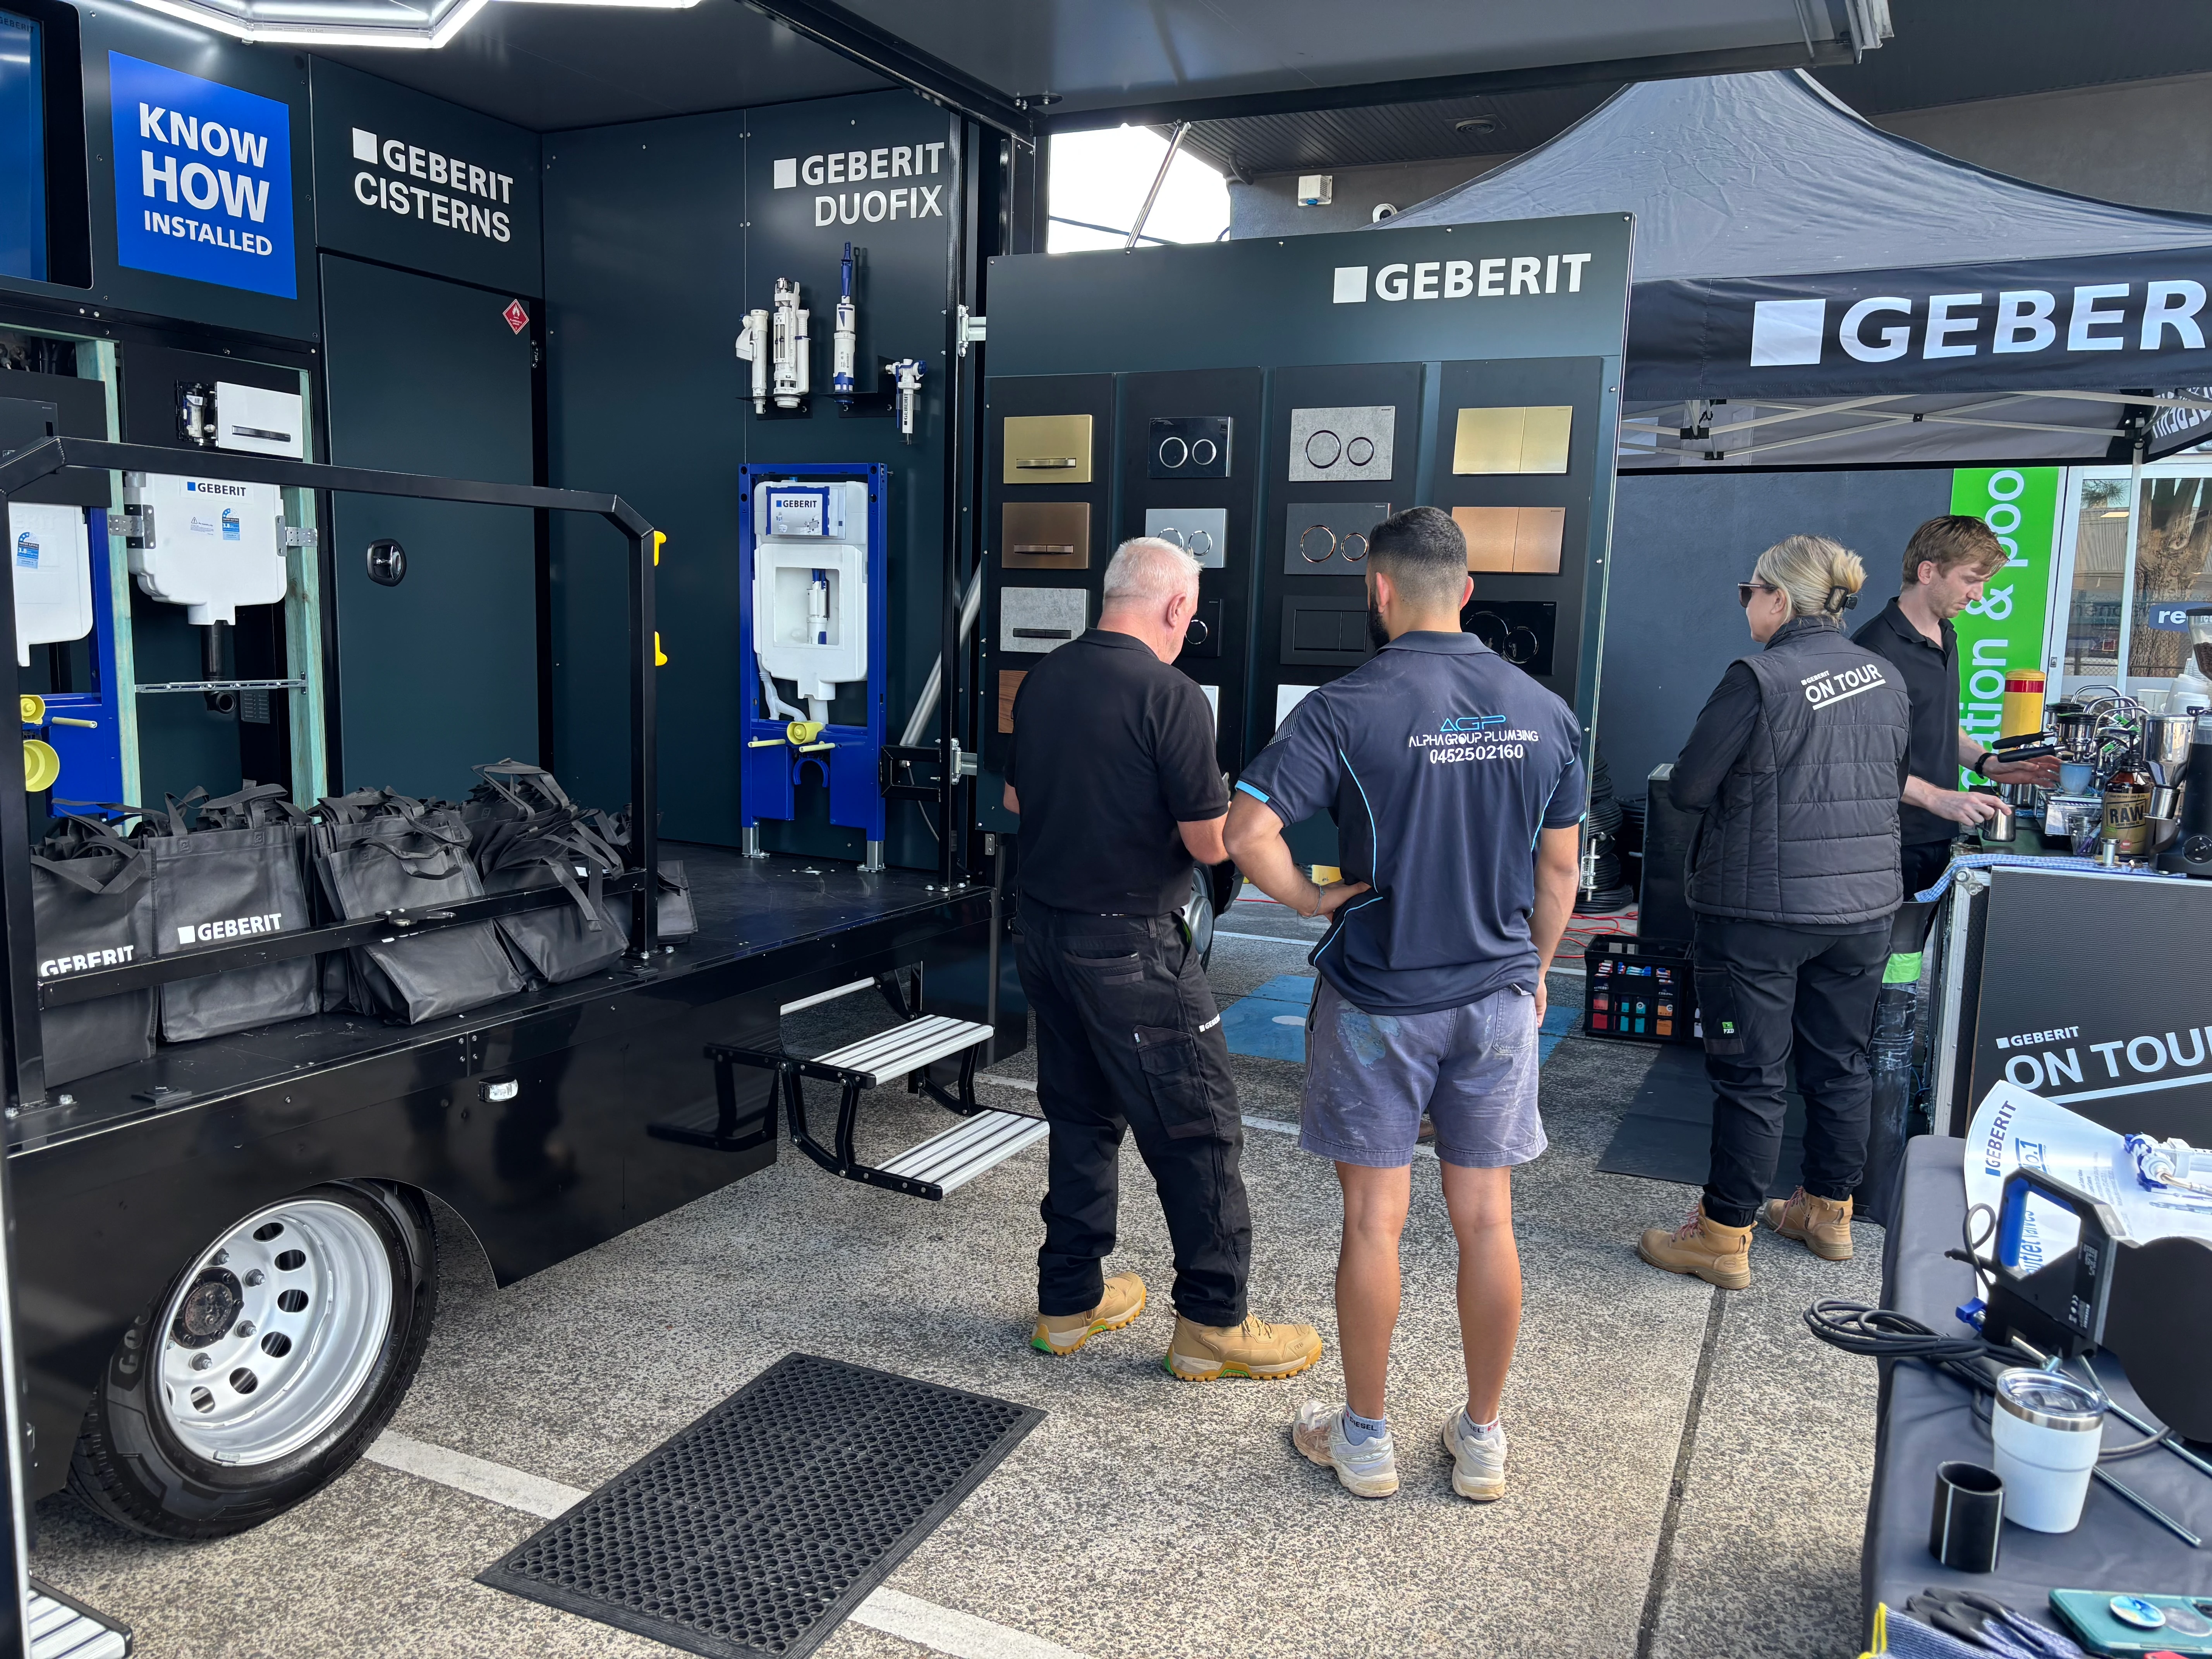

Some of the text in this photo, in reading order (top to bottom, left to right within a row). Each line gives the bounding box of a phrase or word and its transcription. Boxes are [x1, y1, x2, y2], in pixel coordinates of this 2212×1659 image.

[140, 102, 268, 168] KNOW
[383, 140, 514, 204] GEBERIT
[802, 142, 945, 186] GEBERIT
[141, 150, 270, 223] HOW
[354, 172, 510, 243] CISTERNS
[816, 185, 943, 227] DUOFIX
[145, 210, 272, 256] INSTALLED
[1376, 253, 1591, 301] GEBERIT
[1839, 280, 2207, 362] GEBER
[198, 483, 246, 496] GEBERIT
[1965, 584, 2013, 621] &
[1805, 664, 1882, 702] ON TOUR
[1806, 670, 1830, 683] GEBERIT
[1440, 715, 1506, 732] AGP
[1484, 730, 1539, 742] PLUMBING
[1430, 744, 1524, 764] 0452502160
[2110, 805, 2144, 824] RAW
[198, 913, 282, 941] GEBERIT
[2011, 1026, 2079, 1046] GEBERIT
[2005, 1025, 2212, 1091] ON TOU
[1985, 1100, 2016, 1168] GEBERIT
[1350, 1417, 1377, 1431] DIESEL
[1463, 1413, 1484, 1433] DIESEL
